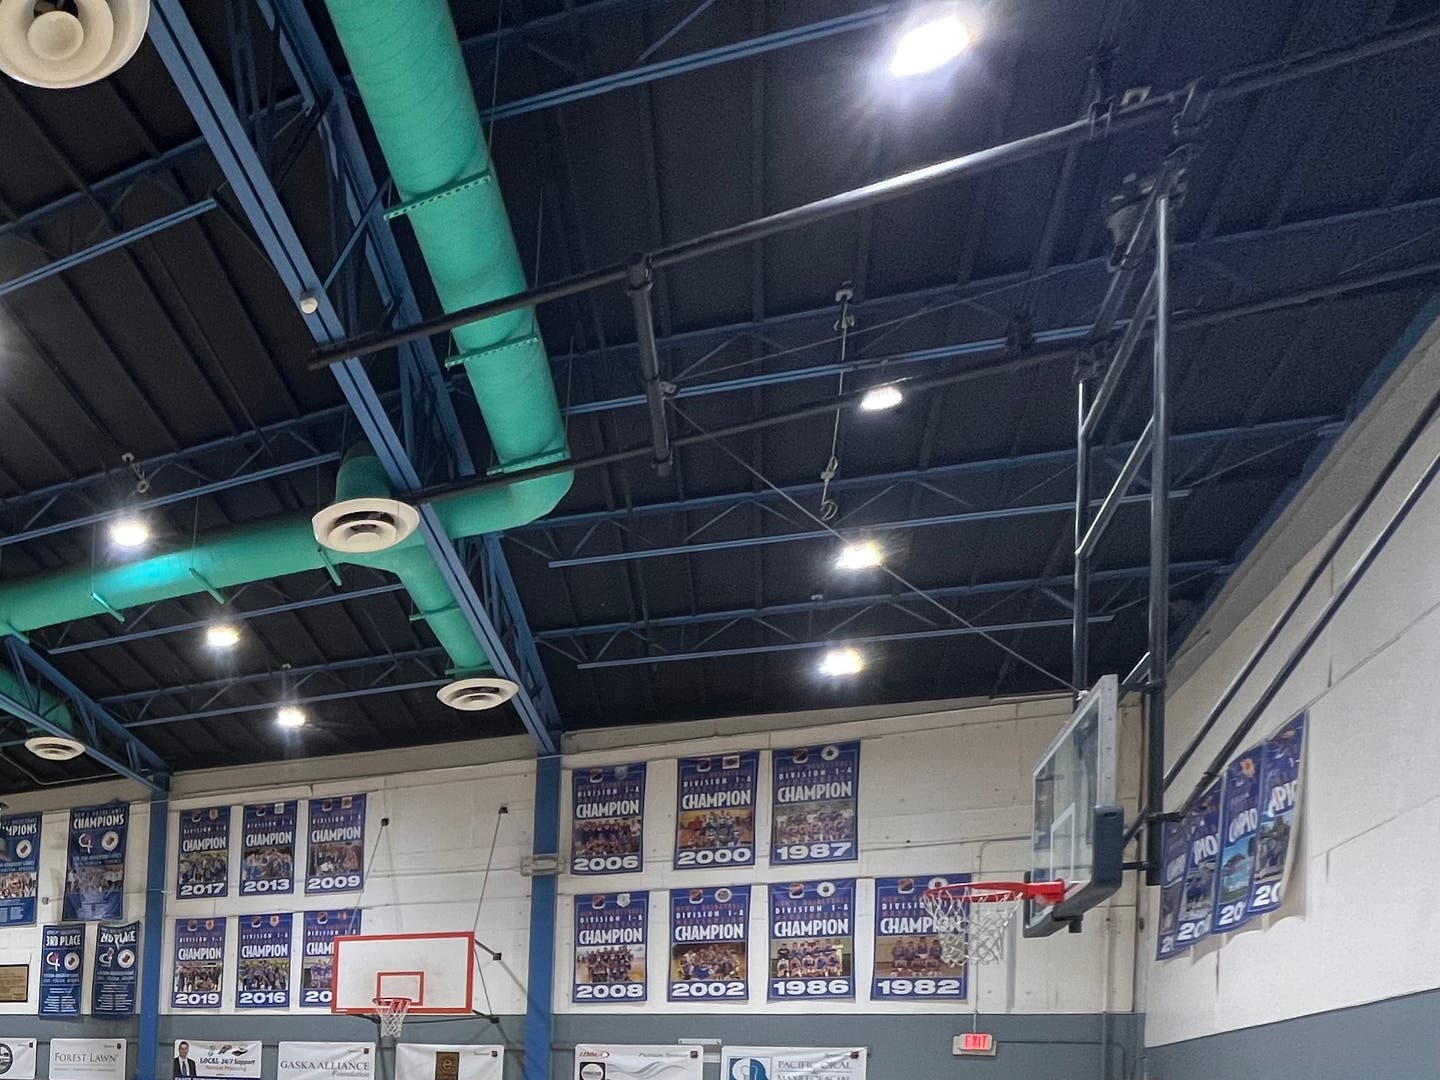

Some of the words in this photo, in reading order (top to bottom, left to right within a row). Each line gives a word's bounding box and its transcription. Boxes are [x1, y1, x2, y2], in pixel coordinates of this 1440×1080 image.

[779, 770, 826, 780] DIVISION
[683, 779, 728, 788] DIVISION
[577, 788, 618, 798] DIVISION
[778, 781, 852, 803] CHAMPION
[682, 790, 751, 810] CHAMPION
[576, 800, 639, 819] CHAMPION
[73, 814, 125, 830] CHAMPIONS
[245, 831, 292, 847] CHAMPION
[311, 826, 361, 843] CHAMPION
[182, 836, 226, 852] CHAMPION
[776, 842, 852, 860] 1987
[573, 856, 638, 871] 2006
[678, 848, 751, 865] 2000
[180, 883, 225, 896] 2017
[243, 879, 290, 893] 2013
[309, 875, 360, 890] 2009
[1251, 882, 1282, 907] 20
[676, 911, 720, 919] DIVISION
[775, 905, 822, 914] DIVISION
[1218, 901, 1247, 926] 20
[580, 915, 621, 924] DIVISION
[675, 924, 744, 941] CHAMPION
[774, 919, 849, 937] CHAMPION
[46, 935, 58, 946] 3RD
[59, 934, 80, 946] PLACE
[579, 928, 643, 945] CHAMPION
[178, 947, 222, 961] CHAMPION
[241, 944, 288, 958] CHAMPION
[306, 942, 334, 955] CHAM
[576, 984, 643, 999] 2008
[672, 982, 744, 997] 2002
[773, 979, 849, 996] 1986
[877, 979, 960, 996] 1982
[175, 993, 219, 1004] 2019
[239, 992, 286, 1004] 2016
[305, 991, 332, 1003] 20
[964, 1035, 987, 1049] EXIT
[54, 1052, 87, 1062] FOREST
[90, 1053, 117, 1062] LAWN
[199, 1057, 220, 1065] LOCAL
[233, 1058, 256, 1067] Support
[280, 1060, 315, 1070] GASKA
[315, 1061, 370, 1070] ALLIANCE
